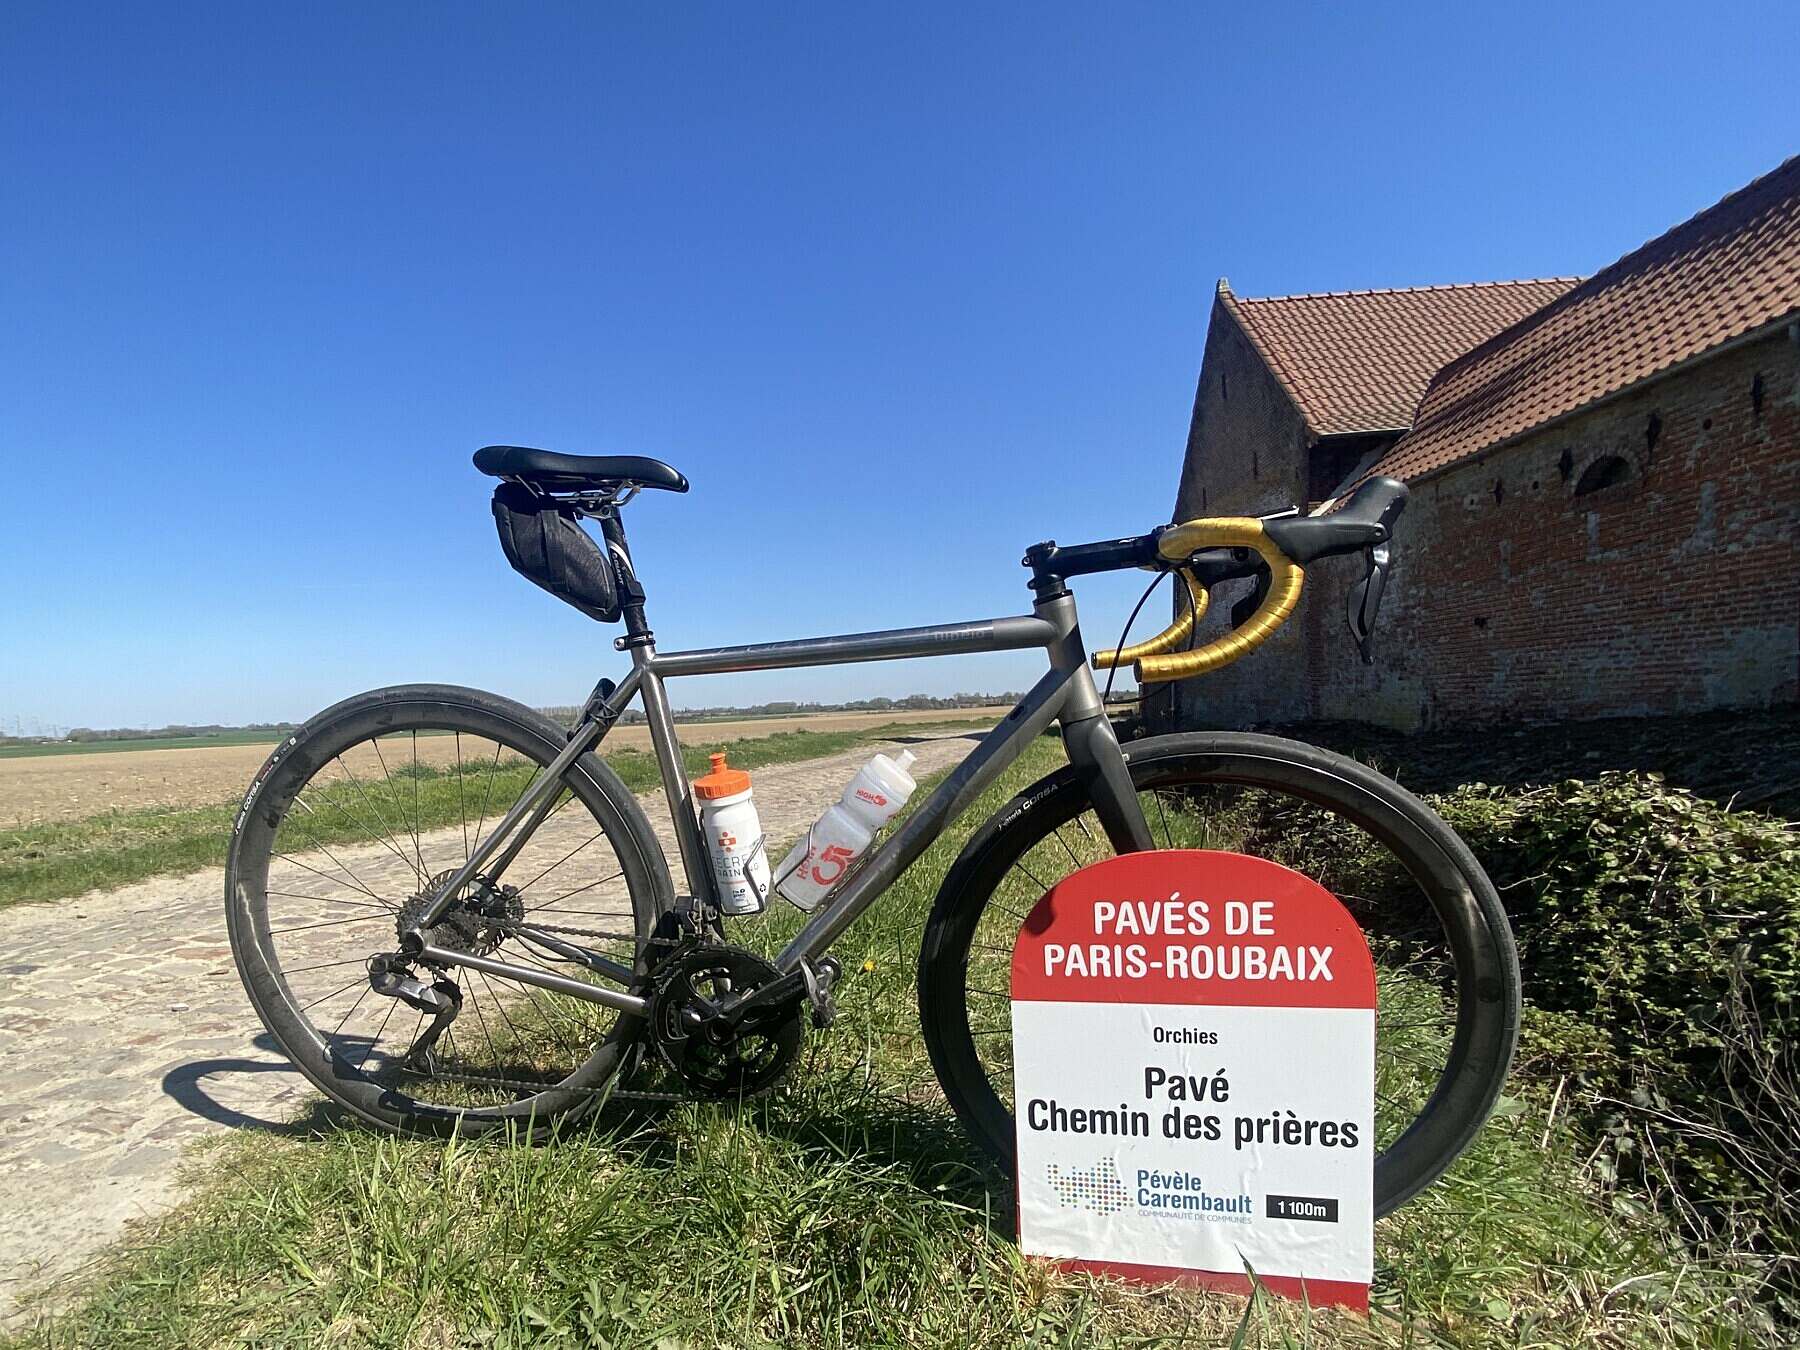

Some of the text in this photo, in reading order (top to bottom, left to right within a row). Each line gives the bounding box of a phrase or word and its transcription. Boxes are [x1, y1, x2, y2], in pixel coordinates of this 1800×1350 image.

[1022, 784, 1058, 810] CORSA
[1094, 892, 1275, 936] PAVÉS DE
[1044, 944, 1334, 981] PARIS-ROUBAIX
[1153, 1026, 1218, 1045] Orchies
[1145, 1067, 1230, 1102] Pavé
[1028, 1099, 1360, 1150] Chemin des prières
[1137, 1169, 1202, 1191] Pévèle
[1137, 1188, 1253, 1214] Carembault
[1194, 1212, 1205, 1221] DE
[1206, 1214, 1253, 1225] COMMUNES
